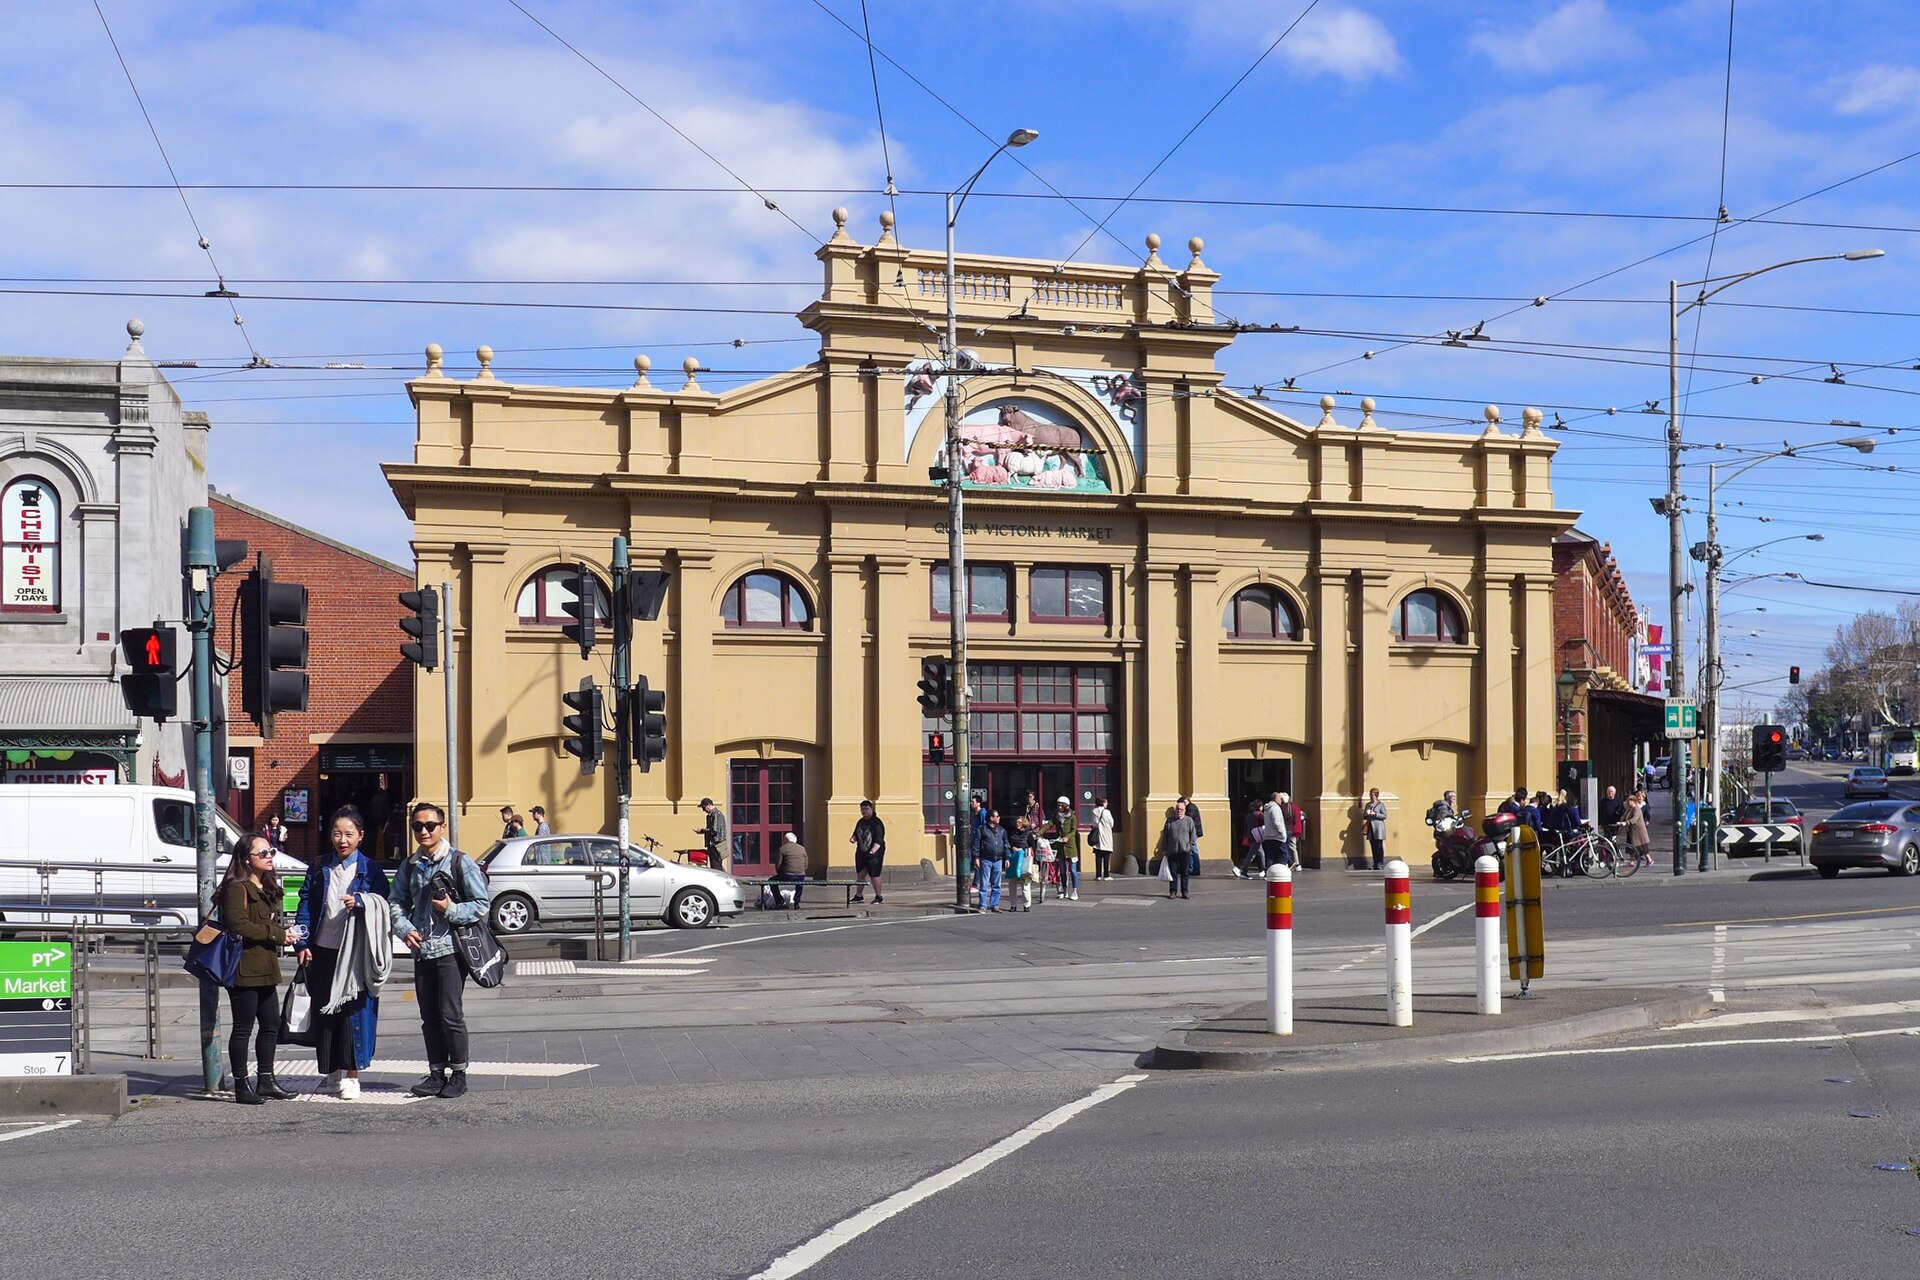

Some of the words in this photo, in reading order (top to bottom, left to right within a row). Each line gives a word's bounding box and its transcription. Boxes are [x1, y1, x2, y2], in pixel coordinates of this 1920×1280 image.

[934, 522, 978, 535] QUEN
[985, 523, 1051, 538] VICTORIA
[1058, 526, 1113, 540] MARKET
[21, 509, 42, 586] CHEMIST
[15, 774, 108, 785] CHEMIST
[5, 978, 66, 993] Market
[23, 1065, 47, 1075] Stop
[55, 1056, 66, 1073] 7
